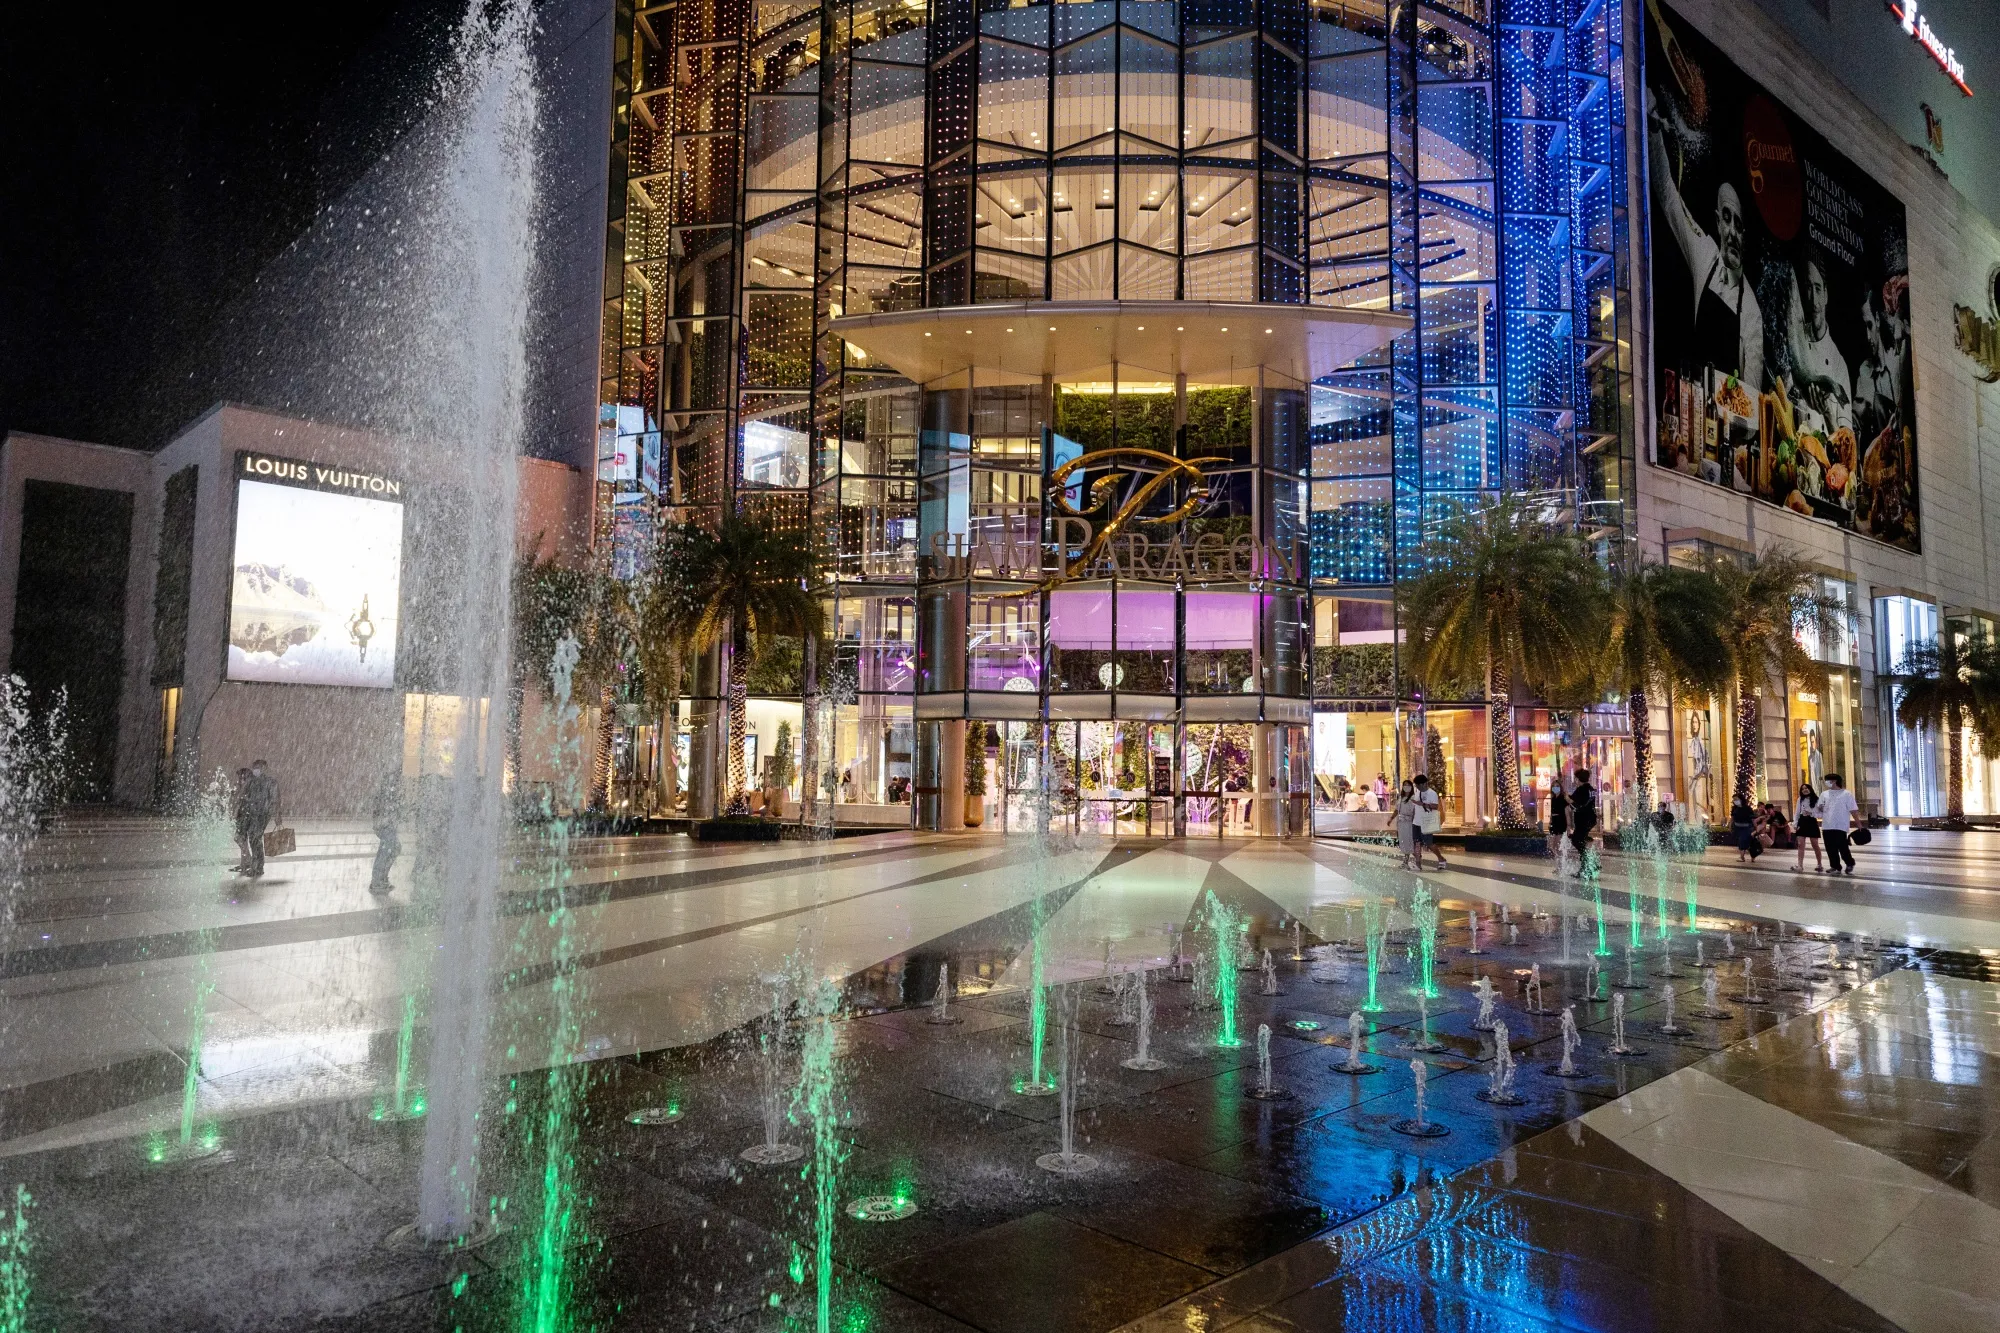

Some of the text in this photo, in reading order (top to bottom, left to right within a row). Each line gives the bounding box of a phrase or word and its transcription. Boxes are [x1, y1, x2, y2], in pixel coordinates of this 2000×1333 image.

[1803, 158, 1864, 219] WORLDCLASS
[1805, 179, 1849, 225] GOURMET
[1807, 199, 1865, 253] DESTINATION
[1809, 222, 1855, 267] Ground Floor
[246, 457, 400, 495] LOUIS VUITTON
[929, 515, 1299, 585] SIAM PARAGON
